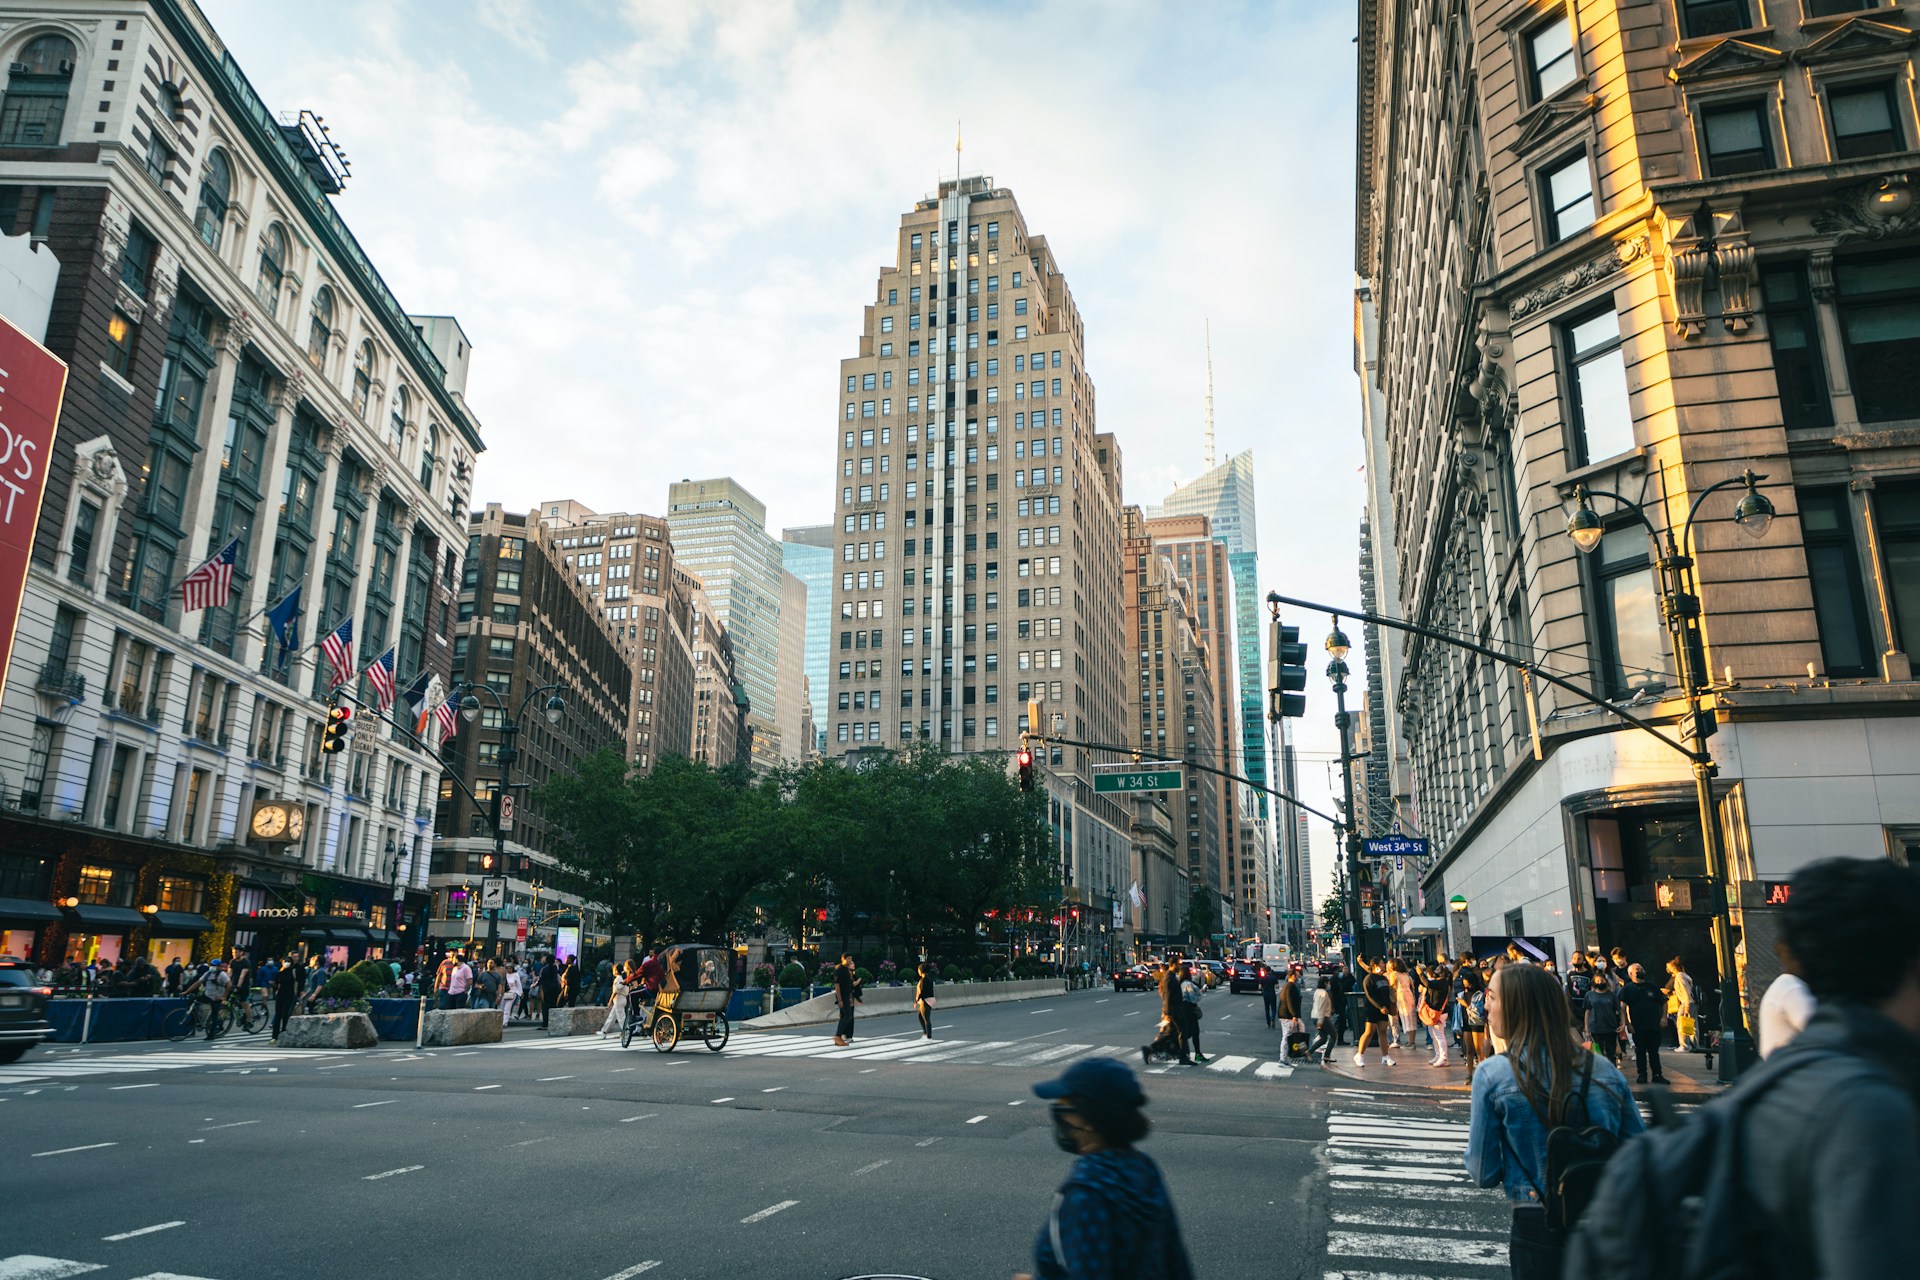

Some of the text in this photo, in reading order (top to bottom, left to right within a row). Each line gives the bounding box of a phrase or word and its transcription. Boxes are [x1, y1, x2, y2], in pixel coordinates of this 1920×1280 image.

[357, 722, 376, 733] BUSES
[357, 731, 374, 742] ONLY
[354, 741, 373, 753] SIGNAL
[1117, 775, 1158, 788] W 34 St
[1369, 842, 1423, 852] West 34th St
[258, 907, 299, 919] macy's
